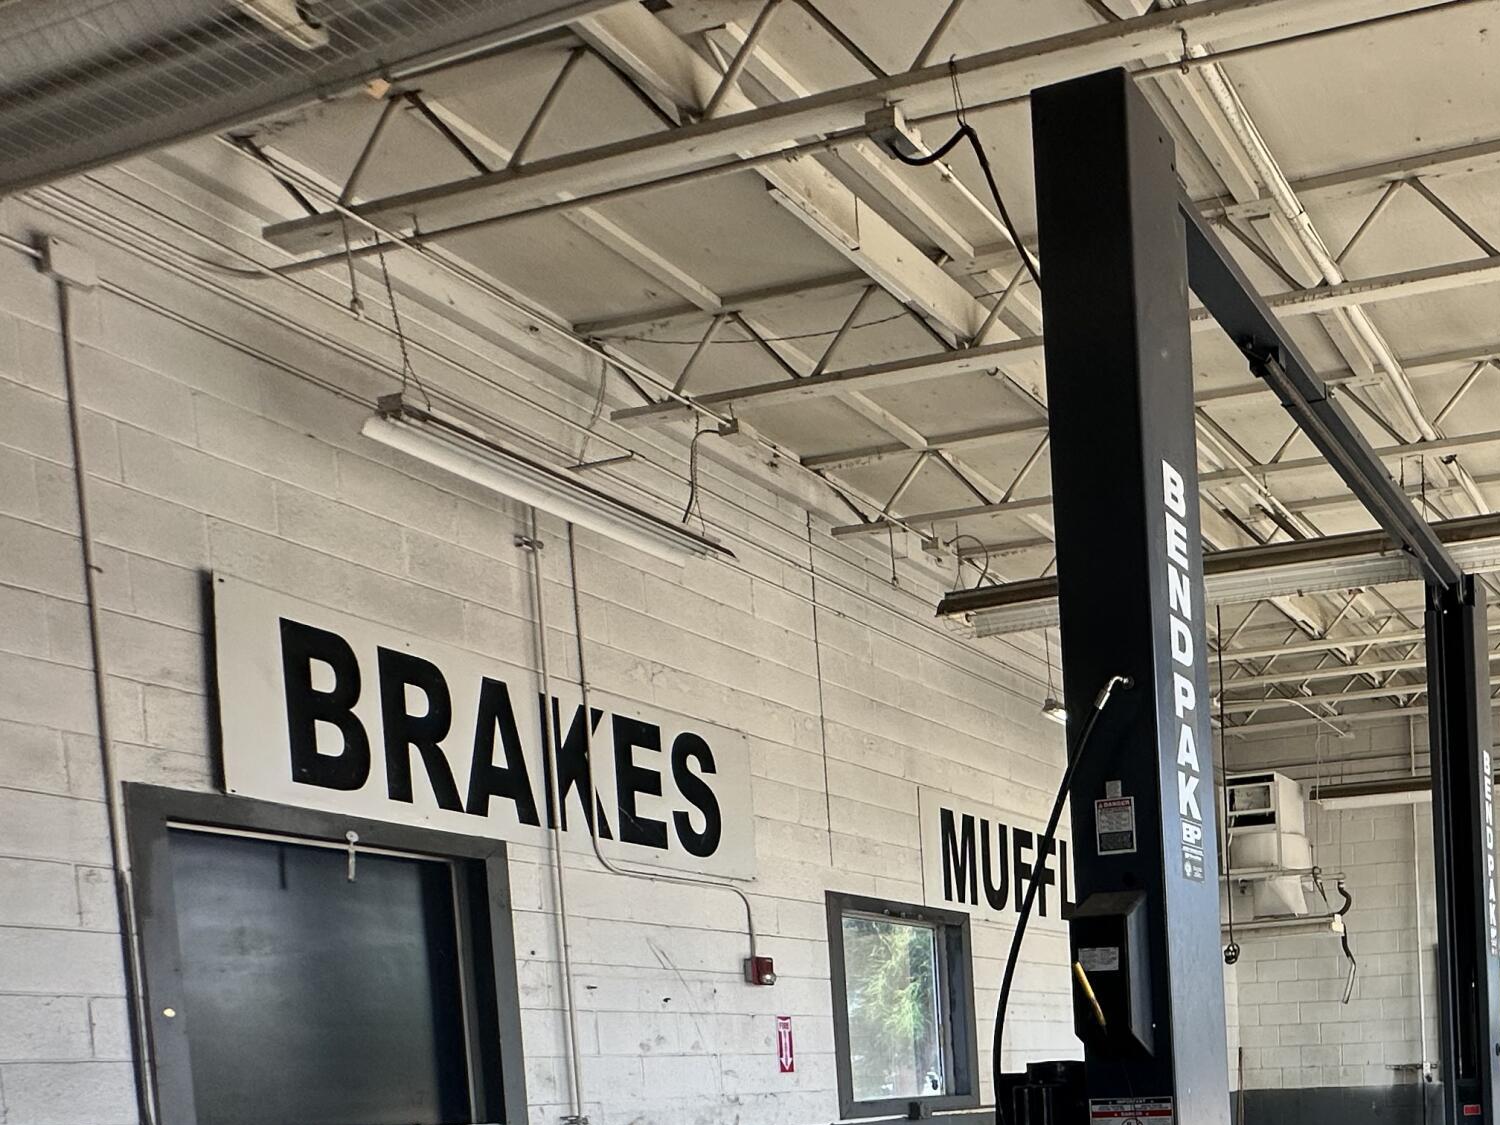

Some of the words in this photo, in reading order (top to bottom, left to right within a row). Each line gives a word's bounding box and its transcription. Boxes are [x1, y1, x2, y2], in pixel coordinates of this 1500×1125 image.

[279, 617, 722, 858] BRAKES
[1161, 459, 1203, 821] BENDPAK
[940, 807, 1076, 921] MUFFL
[1482, 750, 1497, 926] BENDPAK
